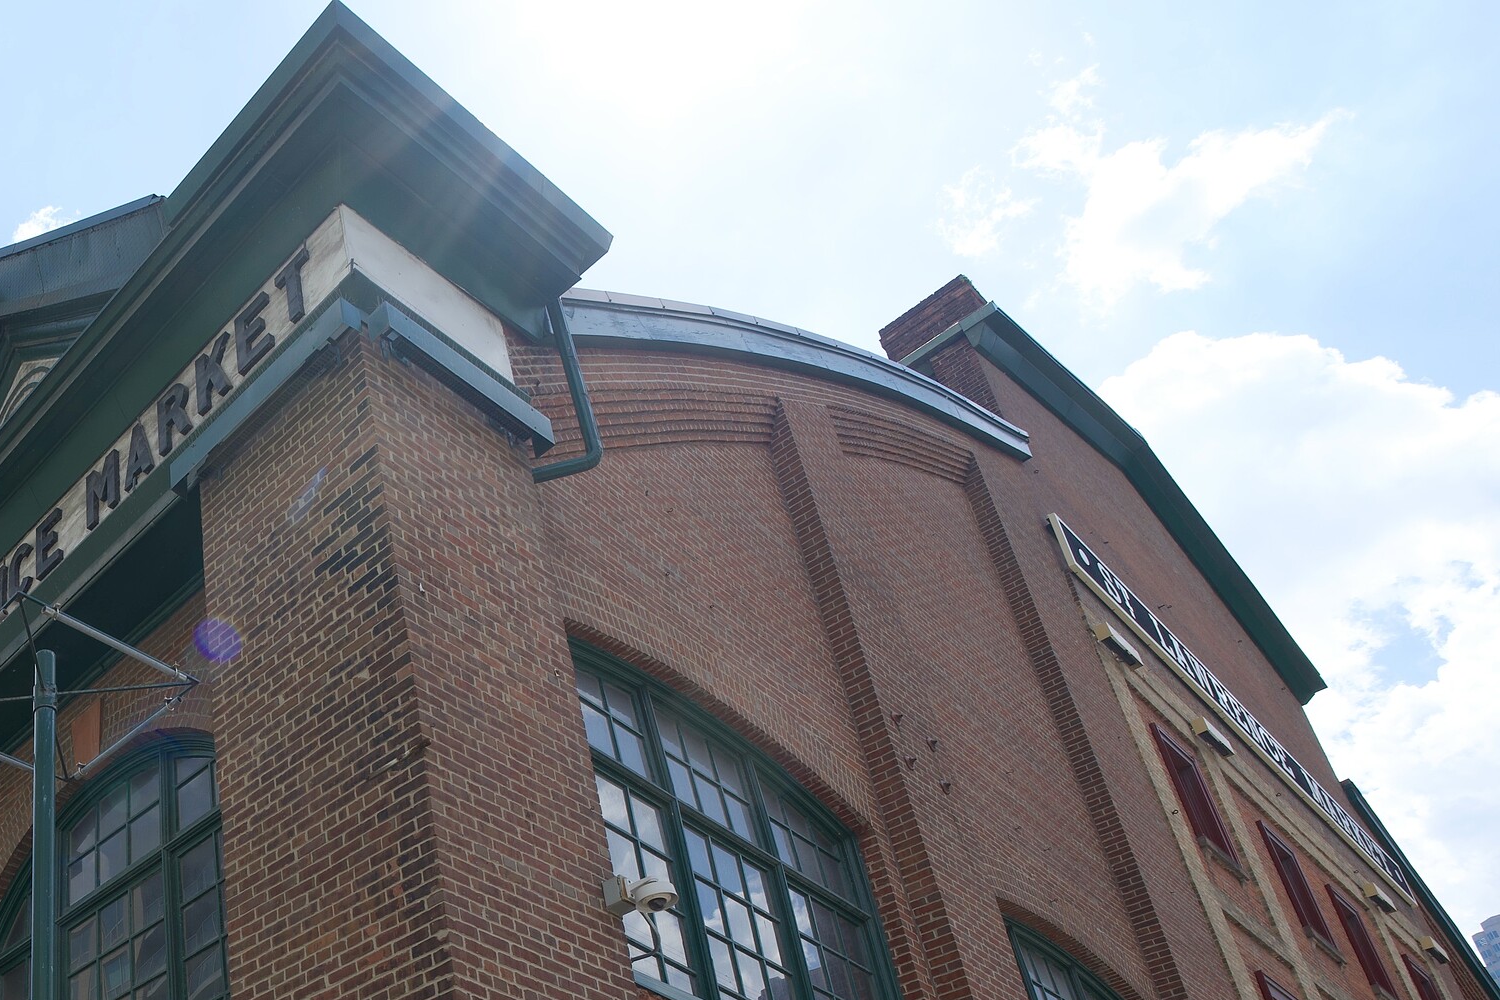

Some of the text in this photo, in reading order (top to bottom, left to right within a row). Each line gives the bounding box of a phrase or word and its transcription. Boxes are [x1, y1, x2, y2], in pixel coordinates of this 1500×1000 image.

[86, 247, 310, 530] MARKET
[1097, 562, 1393, 876] ST LAWRENCE MARKET
